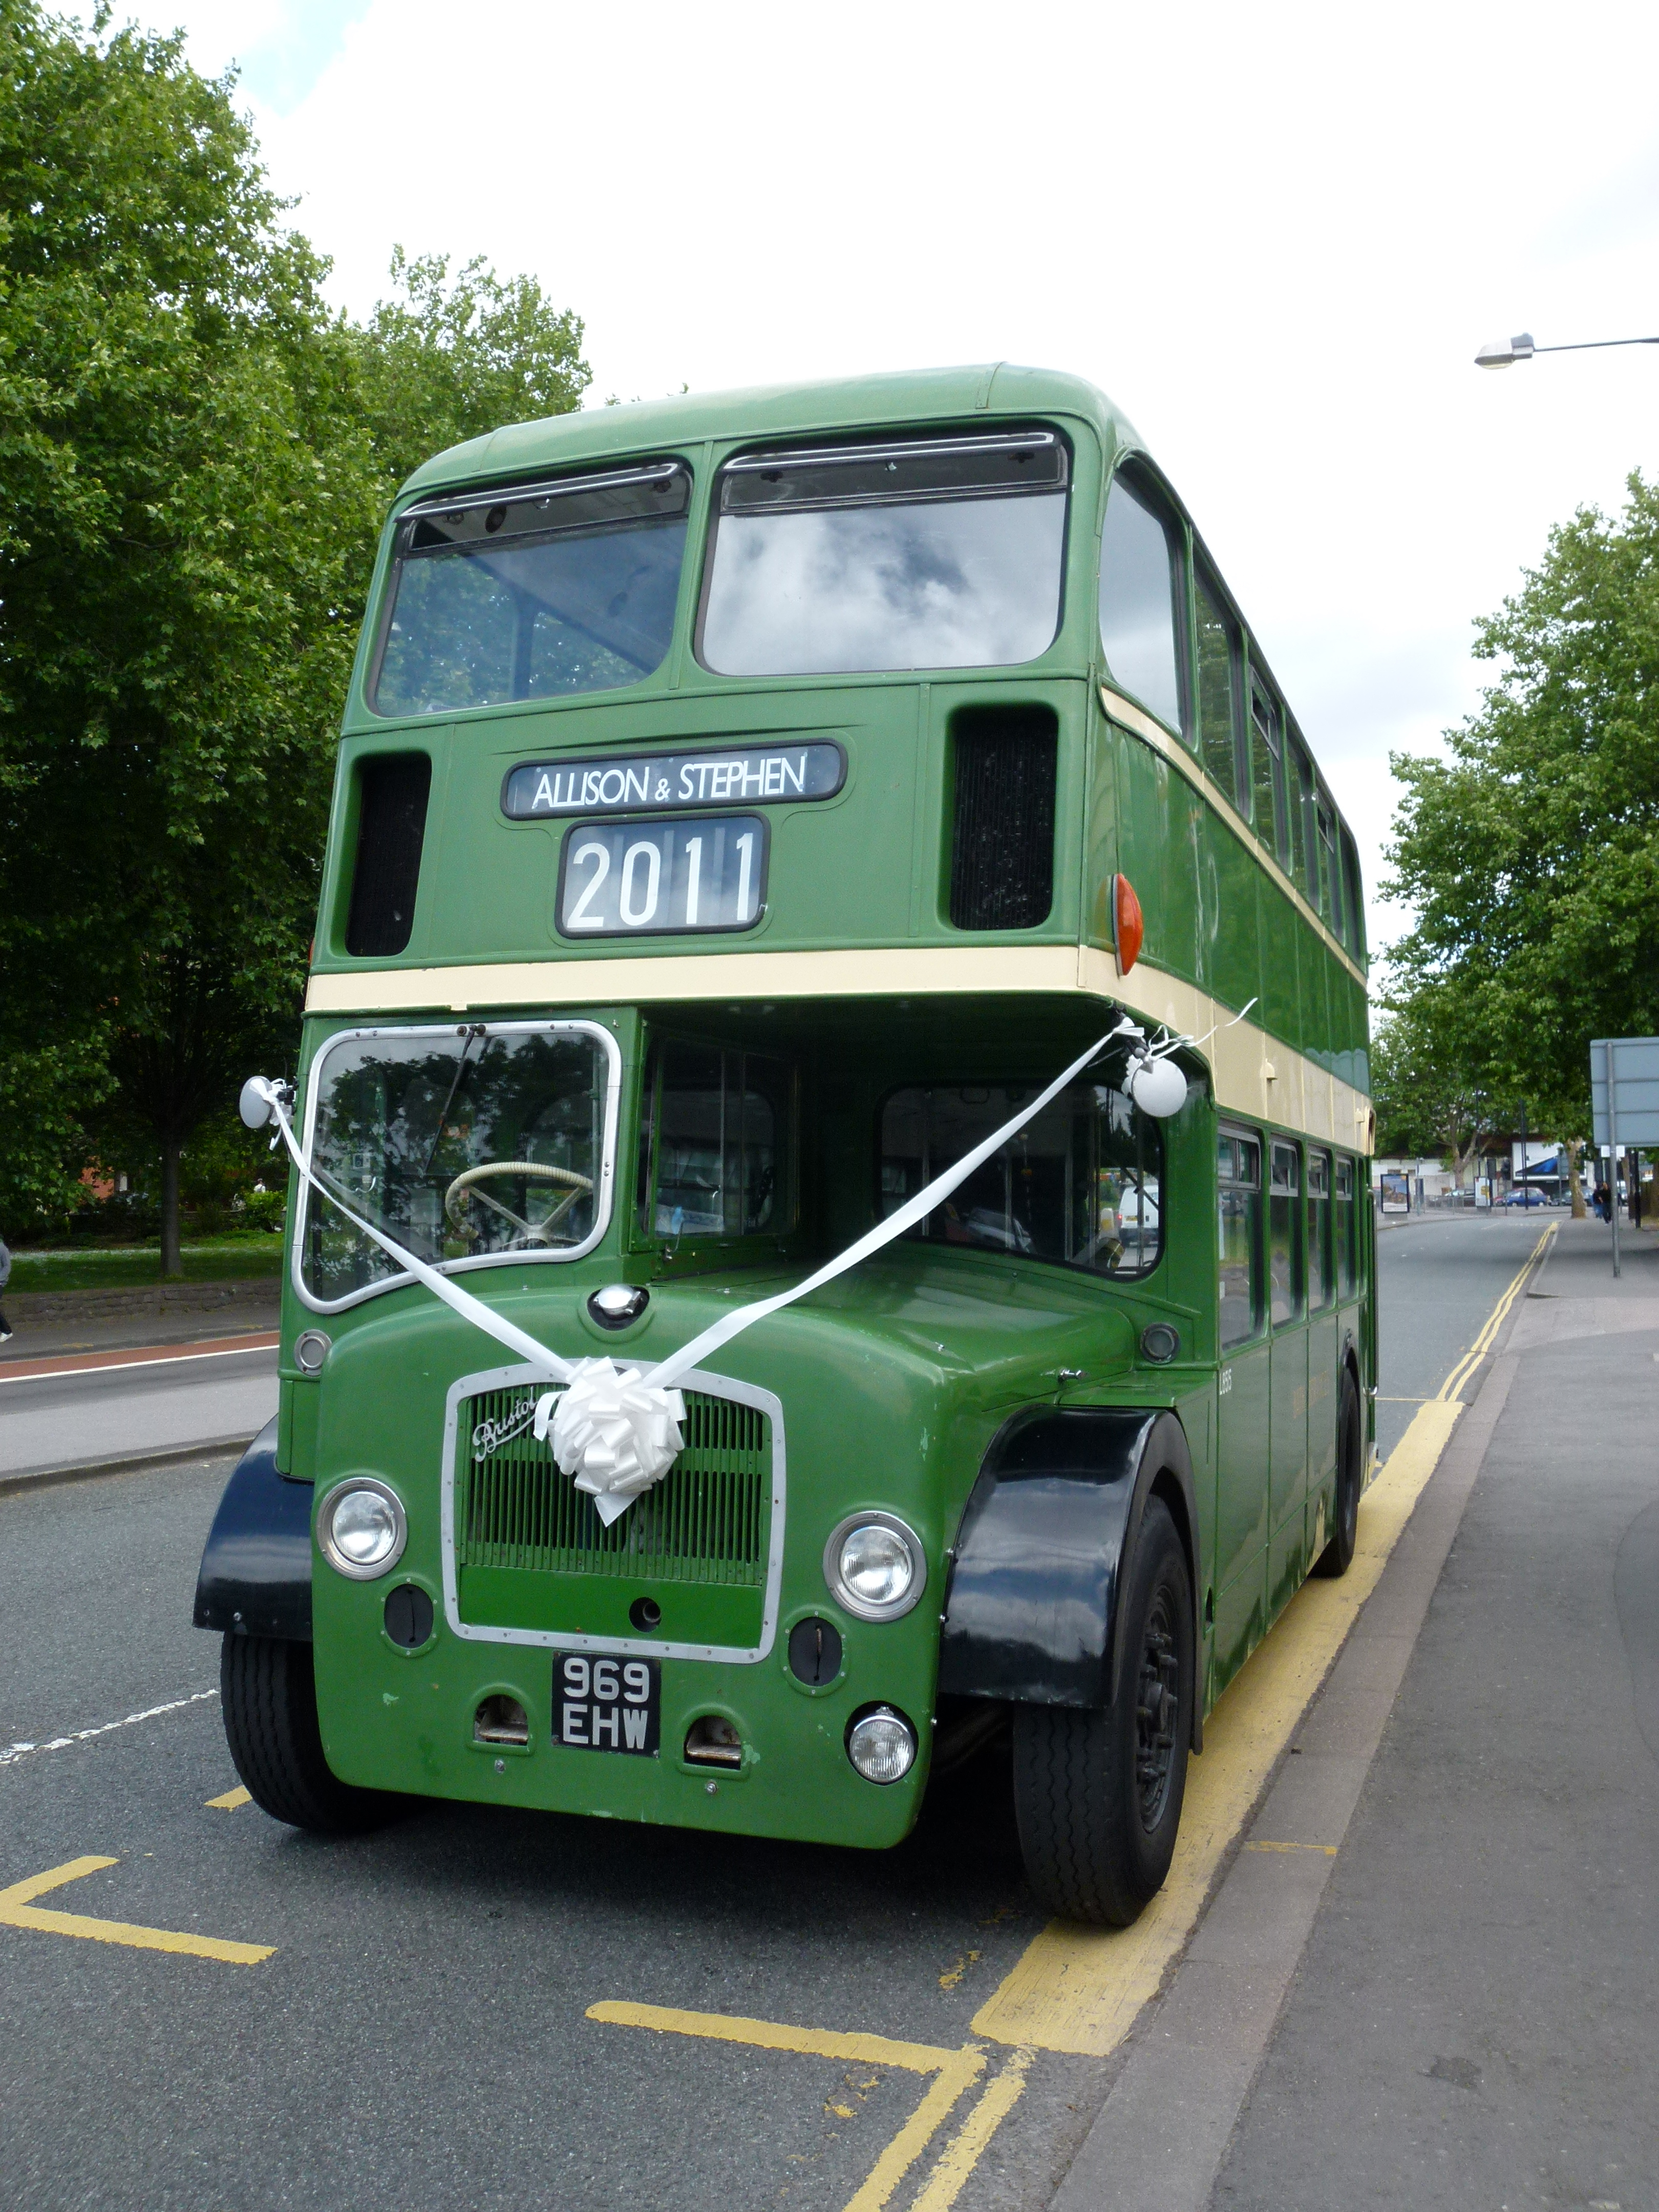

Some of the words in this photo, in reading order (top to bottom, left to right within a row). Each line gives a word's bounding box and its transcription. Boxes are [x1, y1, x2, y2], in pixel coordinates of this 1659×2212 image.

[531, 766, 650, 809] ALLISON
[654, 778, 670, 801] &
[678, 755, 805, 799] STEPHEN
[567, 833, 753, 928] 2011
[473, 1386, 539, 1462] Bristol
[564, 1657, 650, 1703] 969
[563, 1703, 648, 1750] EHW
